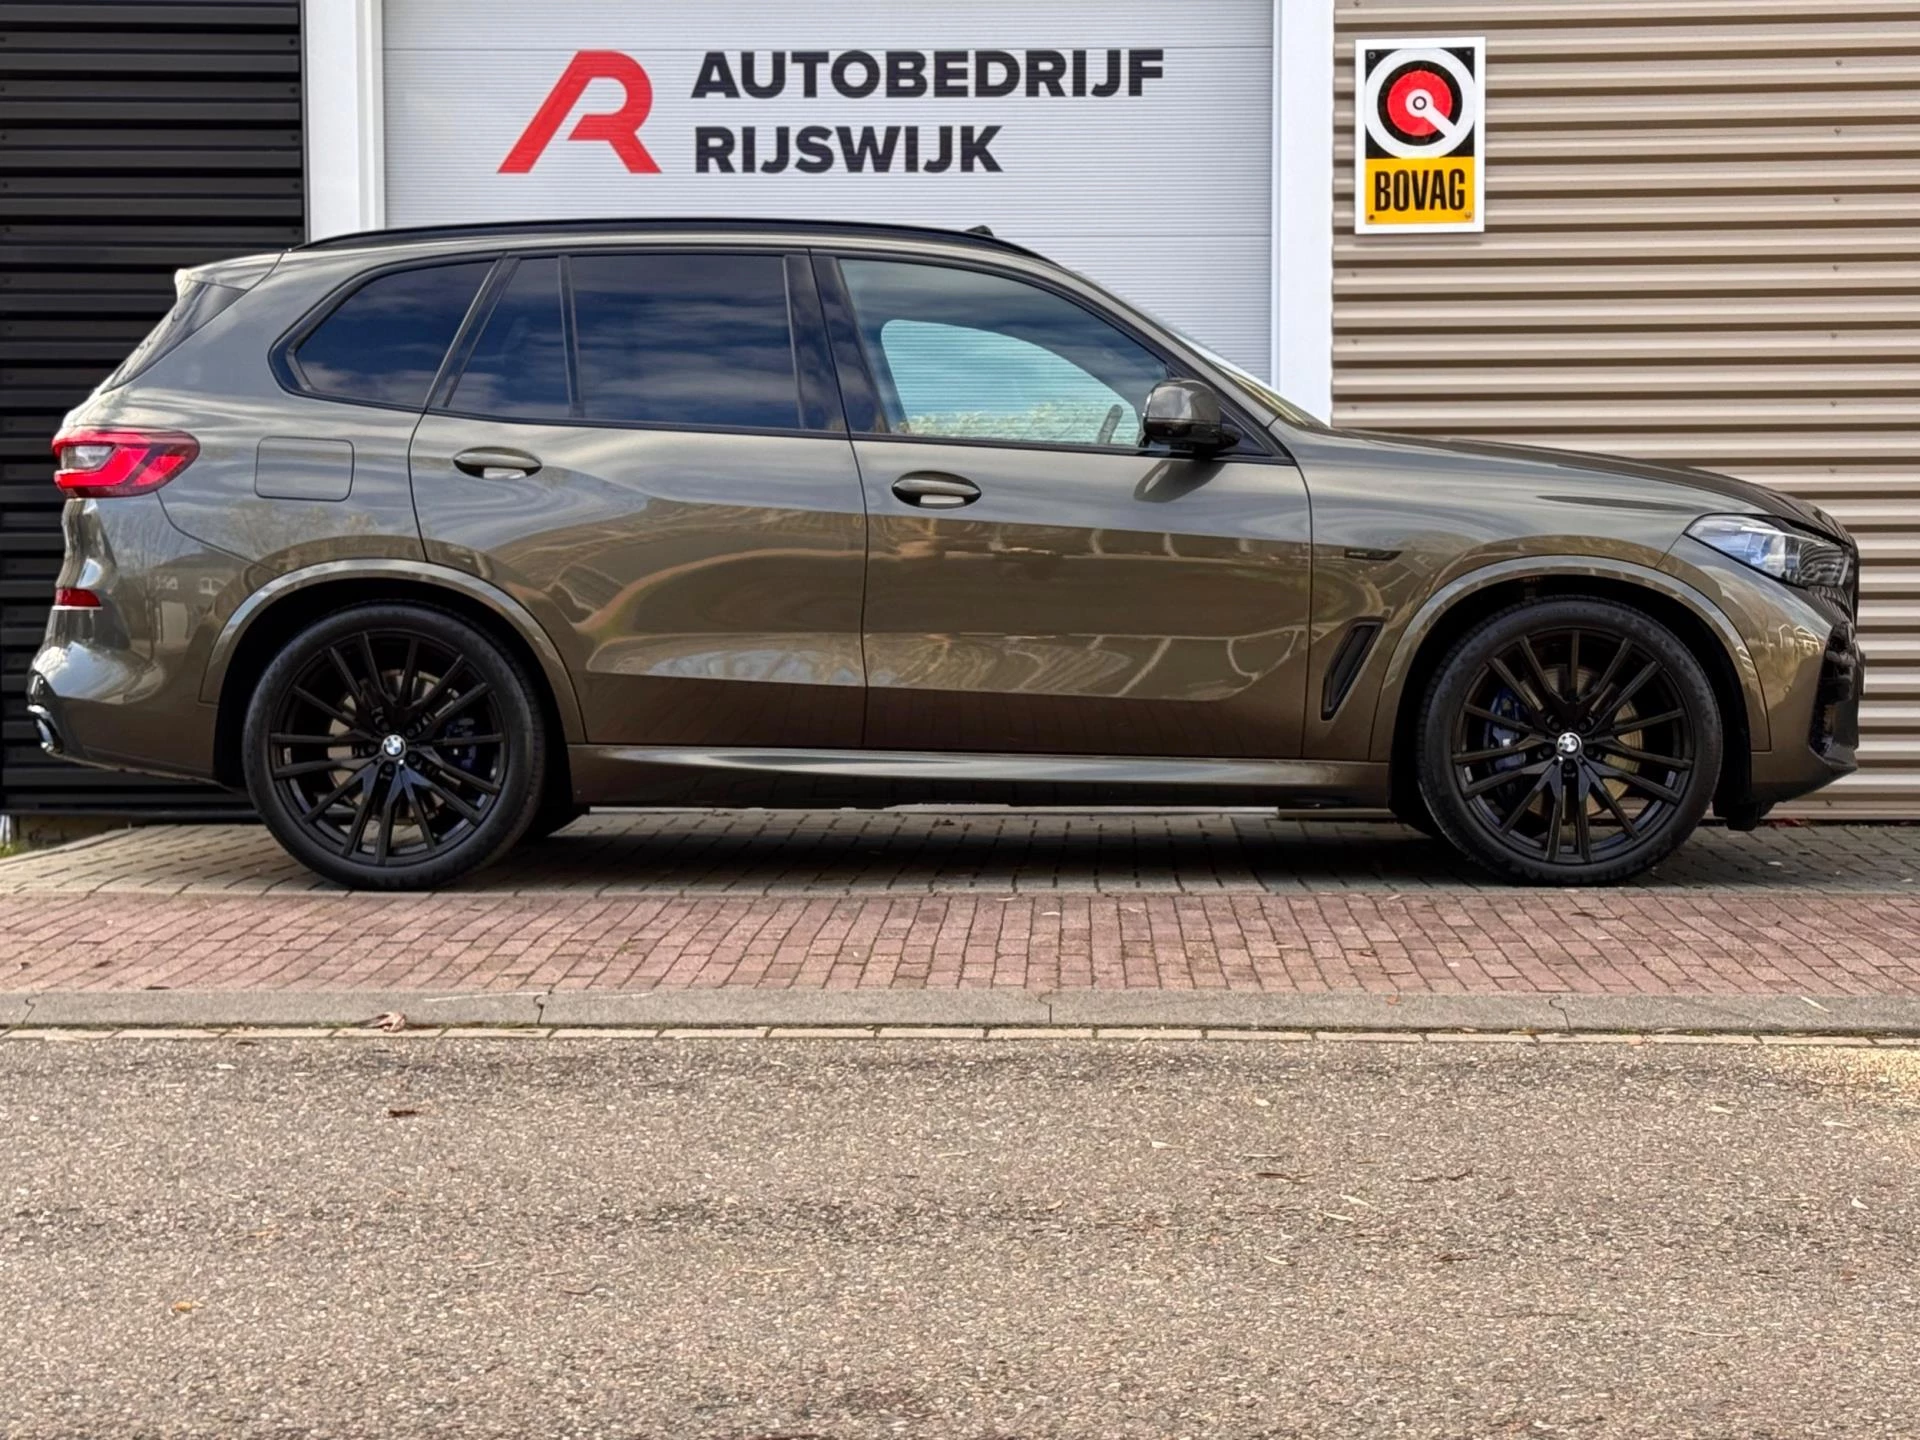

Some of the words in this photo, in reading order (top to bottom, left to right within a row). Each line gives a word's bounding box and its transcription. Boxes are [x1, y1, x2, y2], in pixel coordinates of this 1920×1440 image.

[690, 49, 1164, 99] AUTOBEDRIJF
[695, 125, 1003, 174] RIJSWIJK
[1374, 168, 1465, 212] BOVAG
